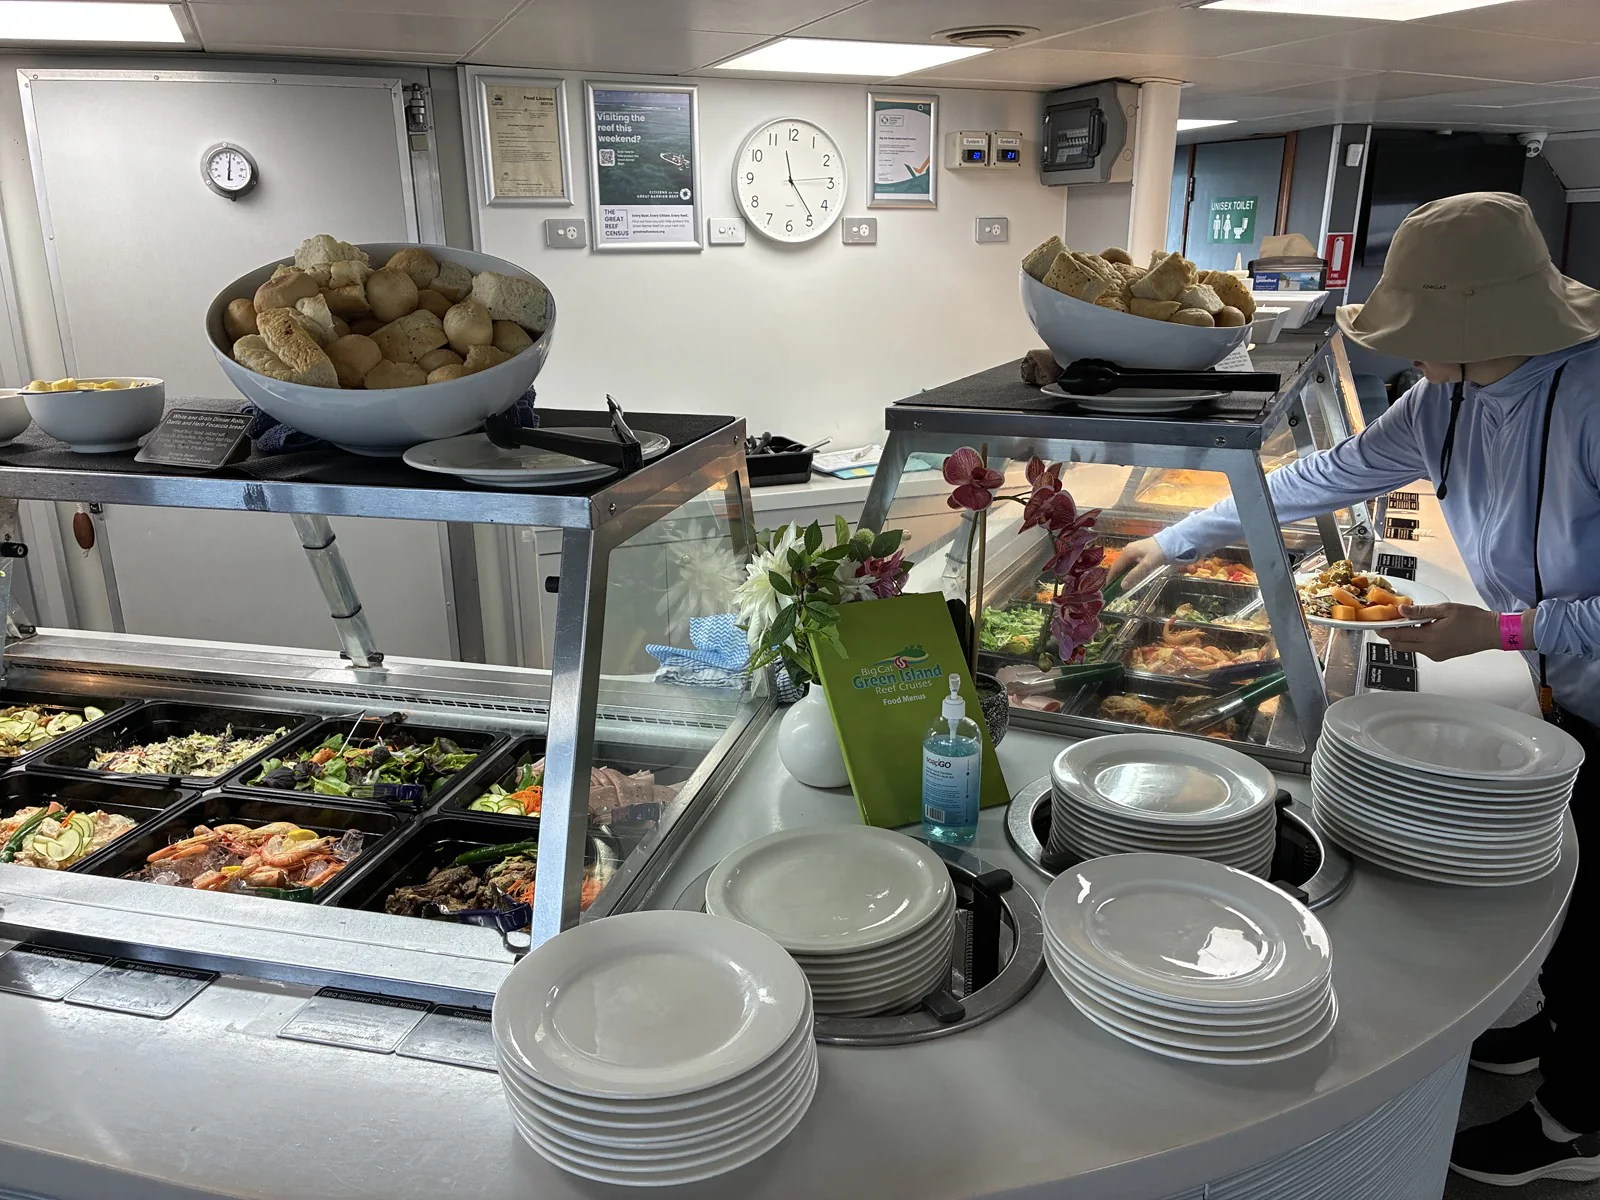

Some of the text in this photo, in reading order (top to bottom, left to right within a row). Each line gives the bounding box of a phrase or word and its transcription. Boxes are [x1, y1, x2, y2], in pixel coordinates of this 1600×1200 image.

[597, 113, 645, 123] Visiting the
[597, 124, 632, 132] reef this
[597, 135, 641, 143] weekend?
[768, 132, 778, 147] 11
[788, 128, 799, 142] 12
[812, 136, 816, 150] 1
[751, 148, 763, 162] 10
[822, 154, 830, 167] 2
[746, 172, 755, 185] 9
[826, 177, 835, 190] 3
[750, 195, 759, 208] 8
[820, 199, 828, 212] 4
[1211, 200, 1255, 211] UNISEX TOILET
[765, 212, 774, 226] 7
[805, 214, 814, 227] 5
[785, 220, 794, 232] 6
[852, 664, 943, 689] Green Island
[861, 665, 893, 676] Big Cat
[875, 680, 933, 694] Reef Cruises
[883, 693, 926, 705] Food Menus
[48, 950, 70, 958] Caught
[337, 993, 370, 1002] Marinated
[371, 999, 398, 1007] Chicken
[398, 1002, 424, 1010] Nibbles
[454, 1011, 492, 1021] Champagn
